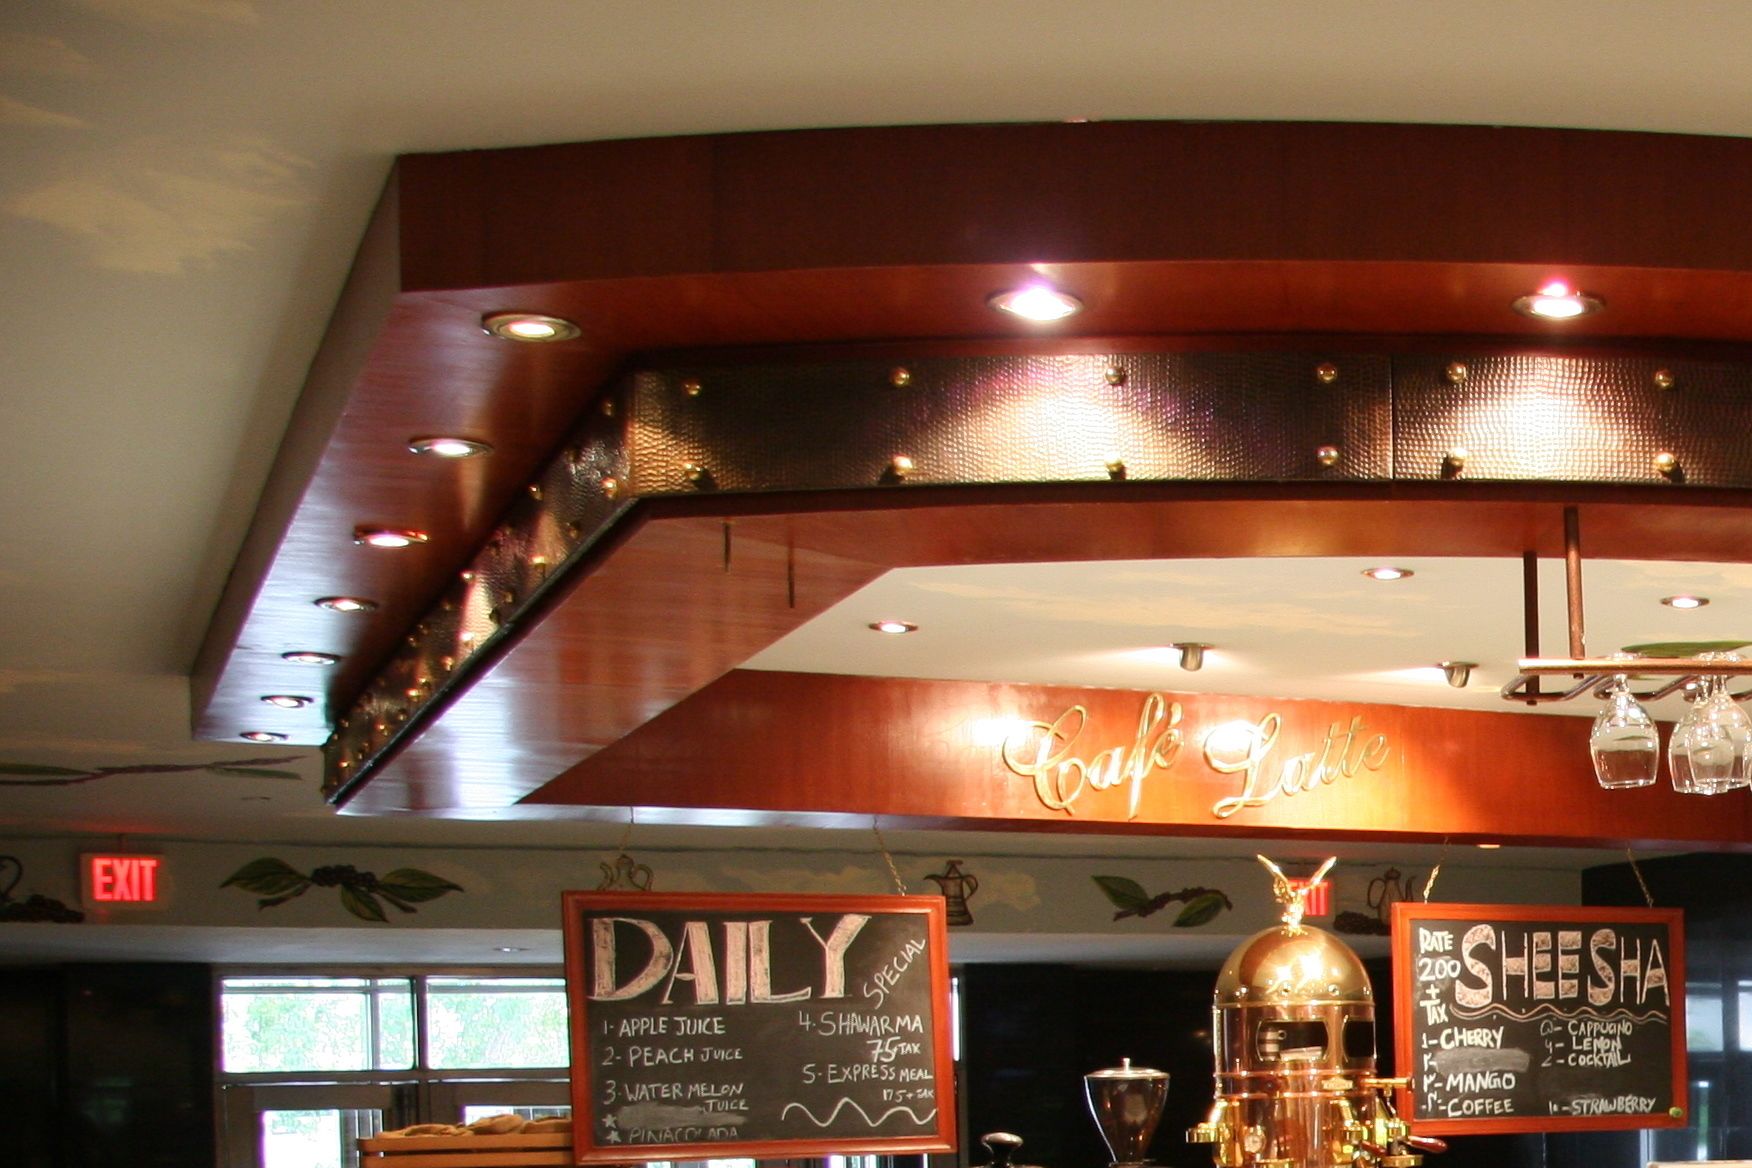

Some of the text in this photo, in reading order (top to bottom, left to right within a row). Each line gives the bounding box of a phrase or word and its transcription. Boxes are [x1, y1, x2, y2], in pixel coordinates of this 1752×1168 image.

[1001, 691, 1392, 822] Café Latte
[92, 857, 157, 901] EXIT
[1418, 927, 1454, 954] RATE
[588, 913, 872, 1006] DAILY
[1418, 957, 1461, 981] 200
[1455, 924, 1671, 1008] SHEESHA
[863, 938, 926, 1010] SPECIAL
[818, 1011, 924, 1037] SHAWARMA
[1419, 998, 1449, 1026] TAX
[619, 1017, 669, 1037] APPLE
[674, 1016, 727, 1036] JUICE
[1572, 1035, 1622, 1052] LEMON
[630, 1046, 694, 1068] PEACH
[701, 1047, 744, 1062] JUICE
[1567, 1052, 1632, 1069] COCKTAIL
[828, 1064, 896, 1083] EXPRESS
[899, 1068, 934, 1082] MEAL
[1446, 1070, 1516, 1093] MANGO
[624, 1082, 683, 1102] WATER
[688, 1082, 744, 1099] MELON
[703, 1099, 749, 1113] JUICE
